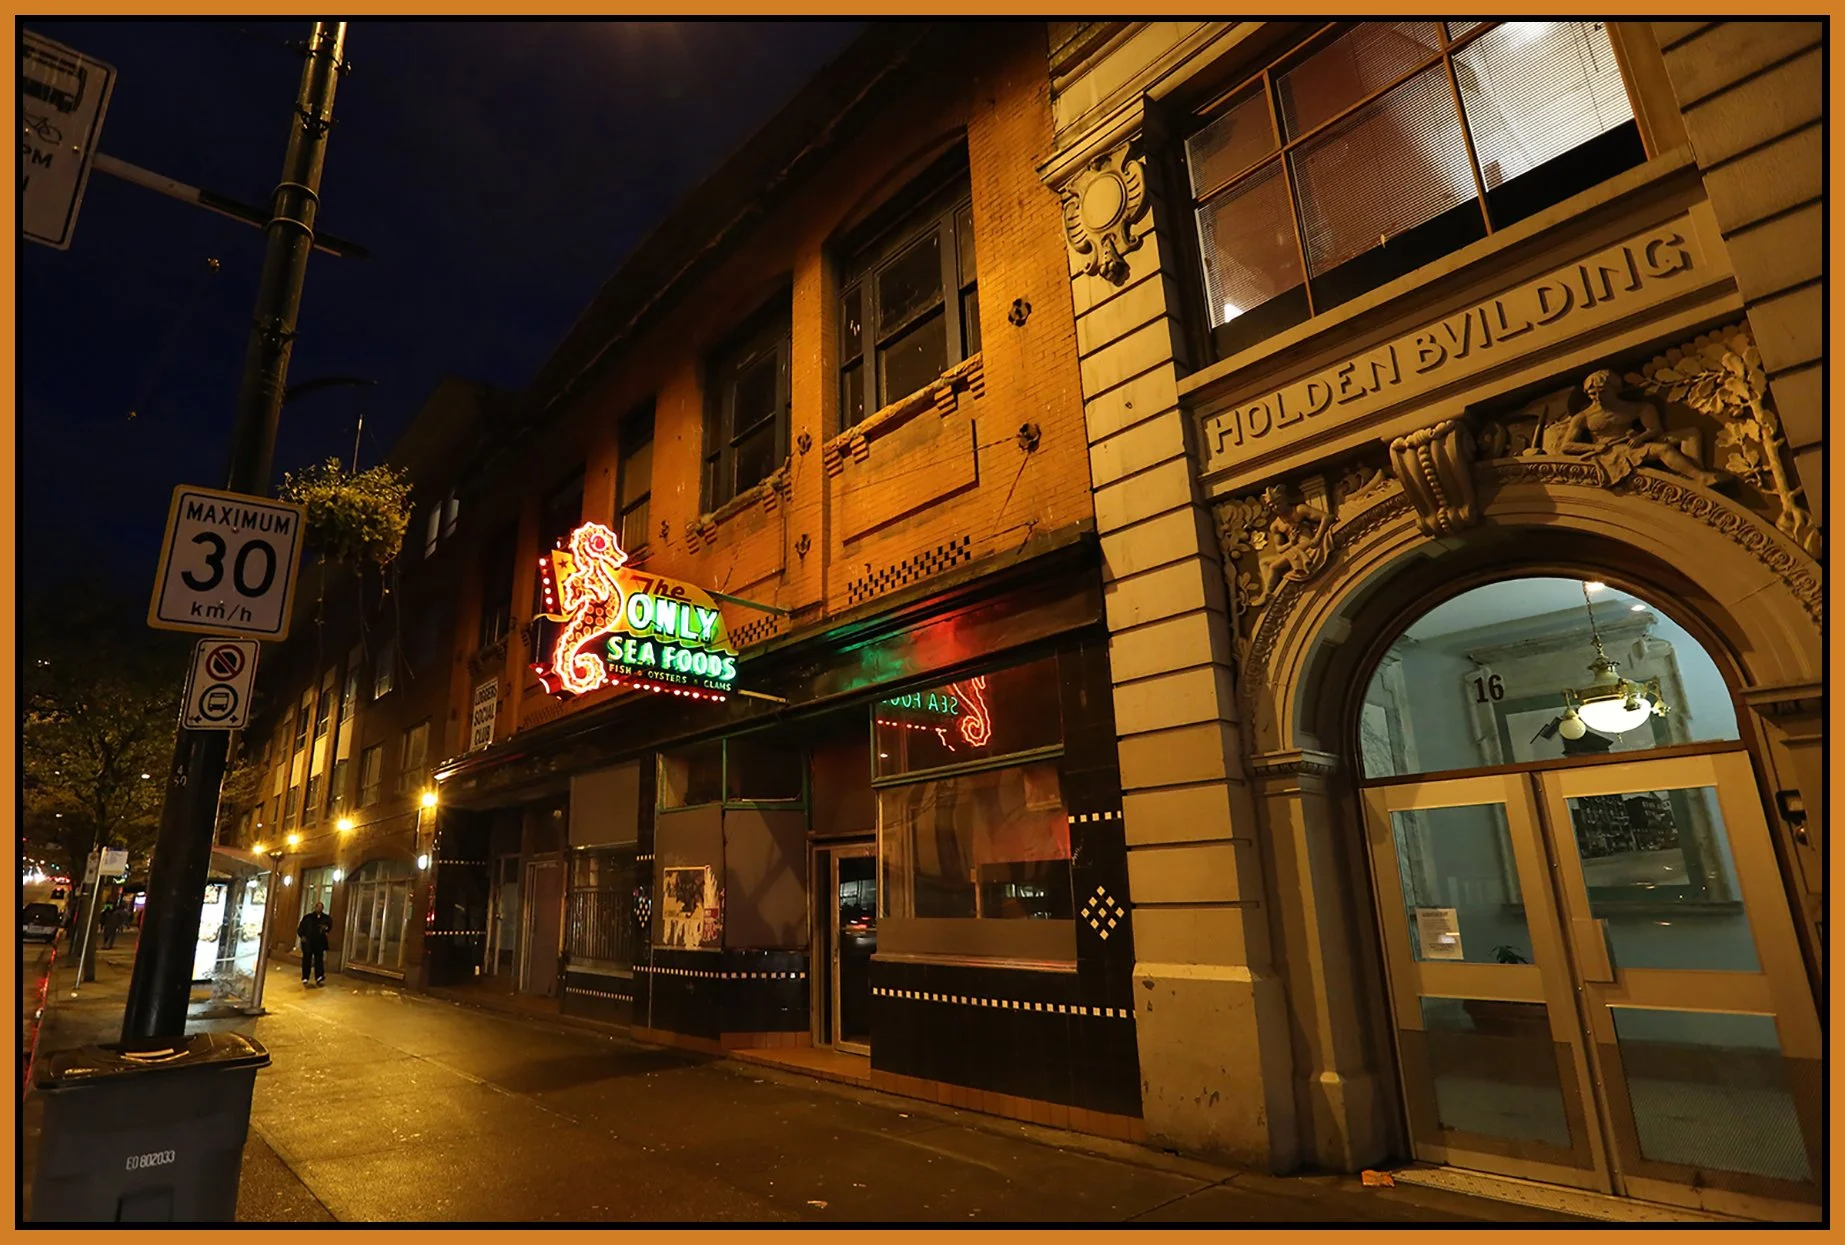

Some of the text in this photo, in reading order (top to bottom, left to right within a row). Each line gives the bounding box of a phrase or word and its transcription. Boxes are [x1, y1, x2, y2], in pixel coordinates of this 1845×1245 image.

[1209, 230, 1694, 454] HOLDEN BVILDING
[186, 501, 290, 535] MAXIMUM
[181, 531, 277, 598] 30
[630, 575, 692, 602] The
[190, 601, 252, 622] km/h
[627, 591, 720, 644] ONLY
[607, 636, 736, 681] SEA FOODS
[609, 664, 732, 692] FISH OYSTERS CLAMS
[1474, 674, 1504, 703] 16
[474, 702, 494, 727] SOCIAL
[475, 725, 490, 746] CLUB
